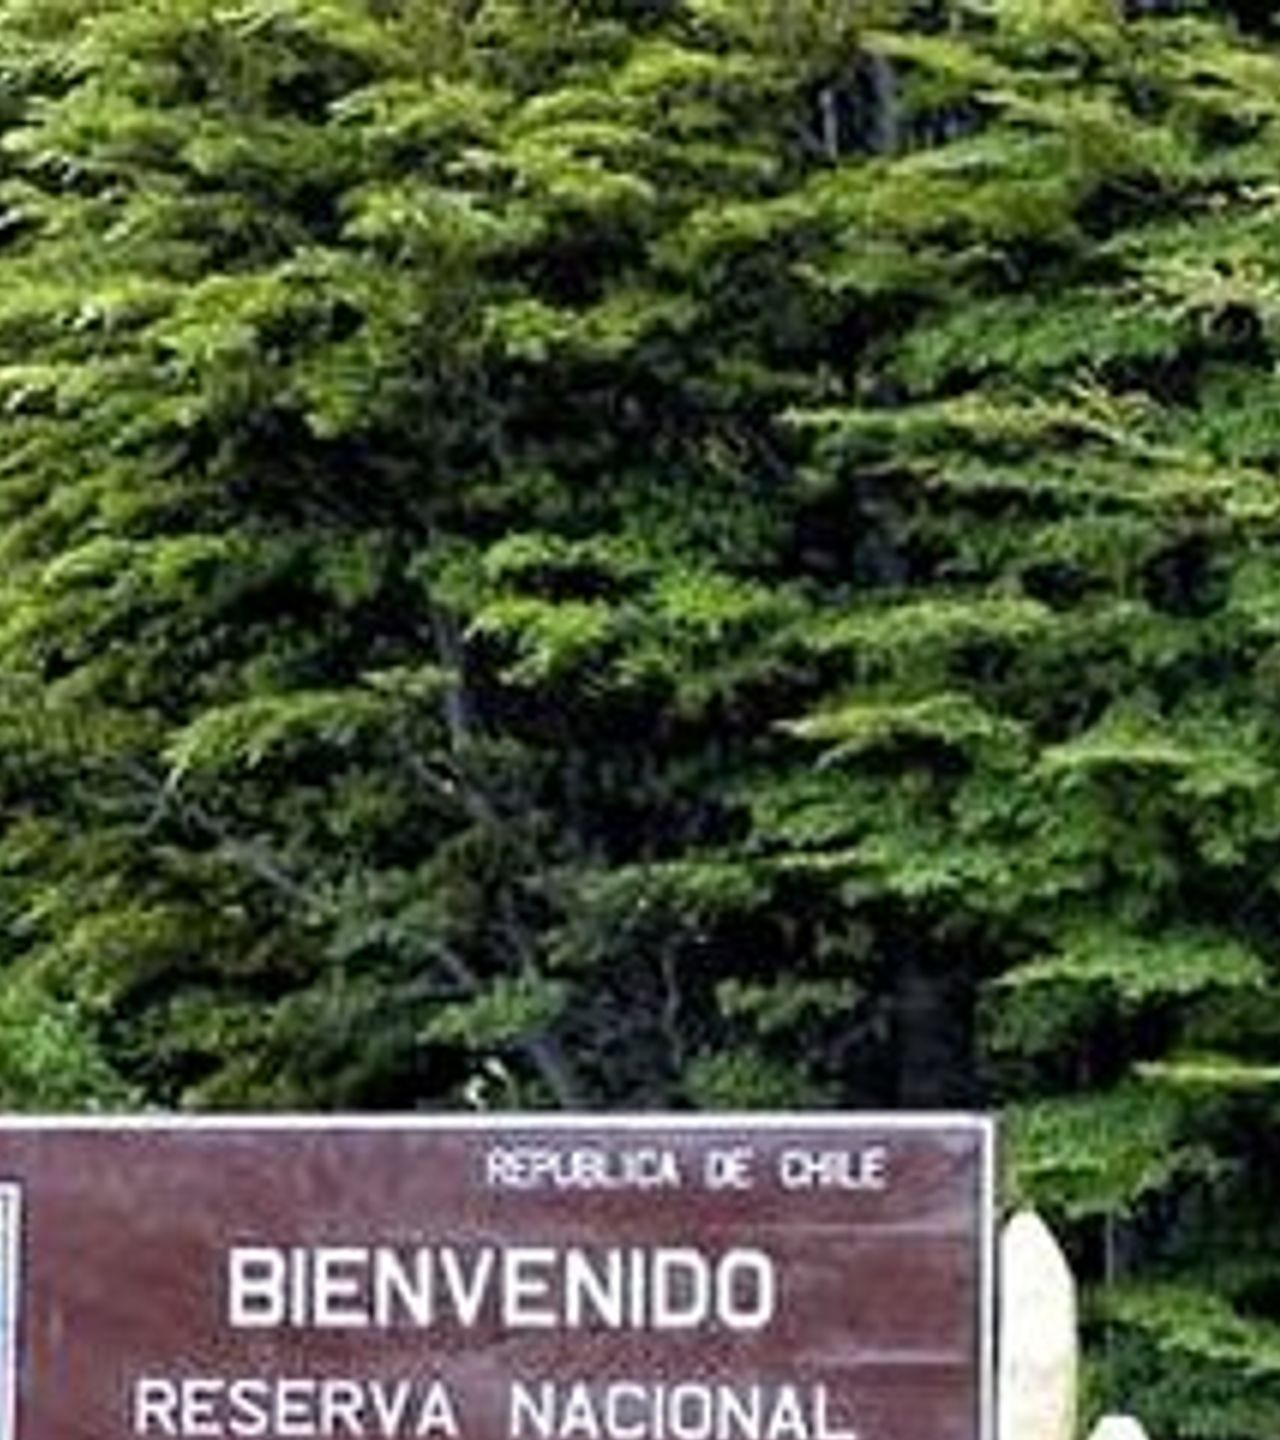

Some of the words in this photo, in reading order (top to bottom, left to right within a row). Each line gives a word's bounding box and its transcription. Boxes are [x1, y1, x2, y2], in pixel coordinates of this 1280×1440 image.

[487, 1145, 681, 1189] REPUBLICA
[705, 1146, 755, 1189] DE
[780, 1145, 888, 1190] CHILE
[227, 1246, 776, 1331] BIENVENIDO
[134, 1378, 461, 1438] RESERVA
